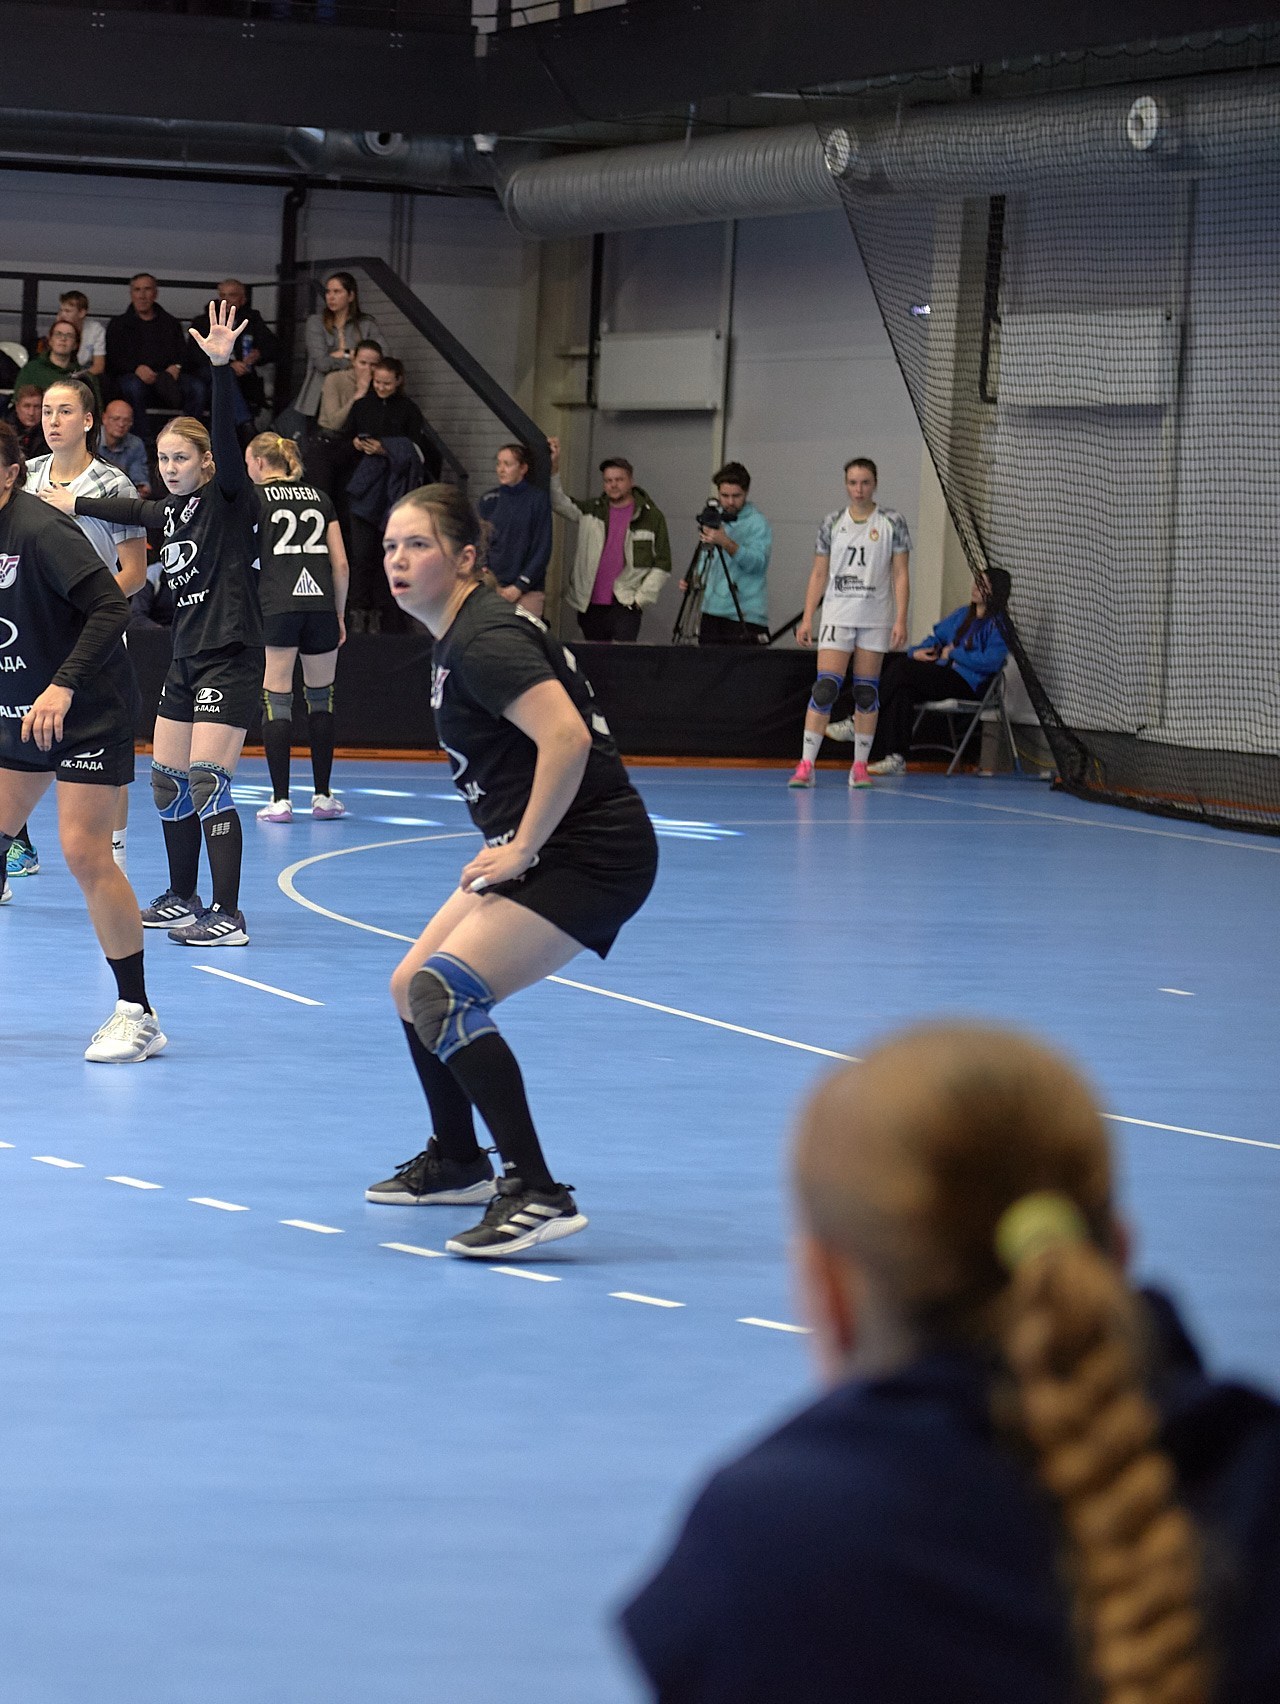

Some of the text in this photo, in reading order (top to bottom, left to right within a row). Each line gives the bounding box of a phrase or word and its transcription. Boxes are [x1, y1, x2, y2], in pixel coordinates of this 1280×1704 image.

[264, 486, 321, 502] ГОЛУБЕВА
[271, 508, 329, 555] 22
[847, 546, 867, 567] 71
